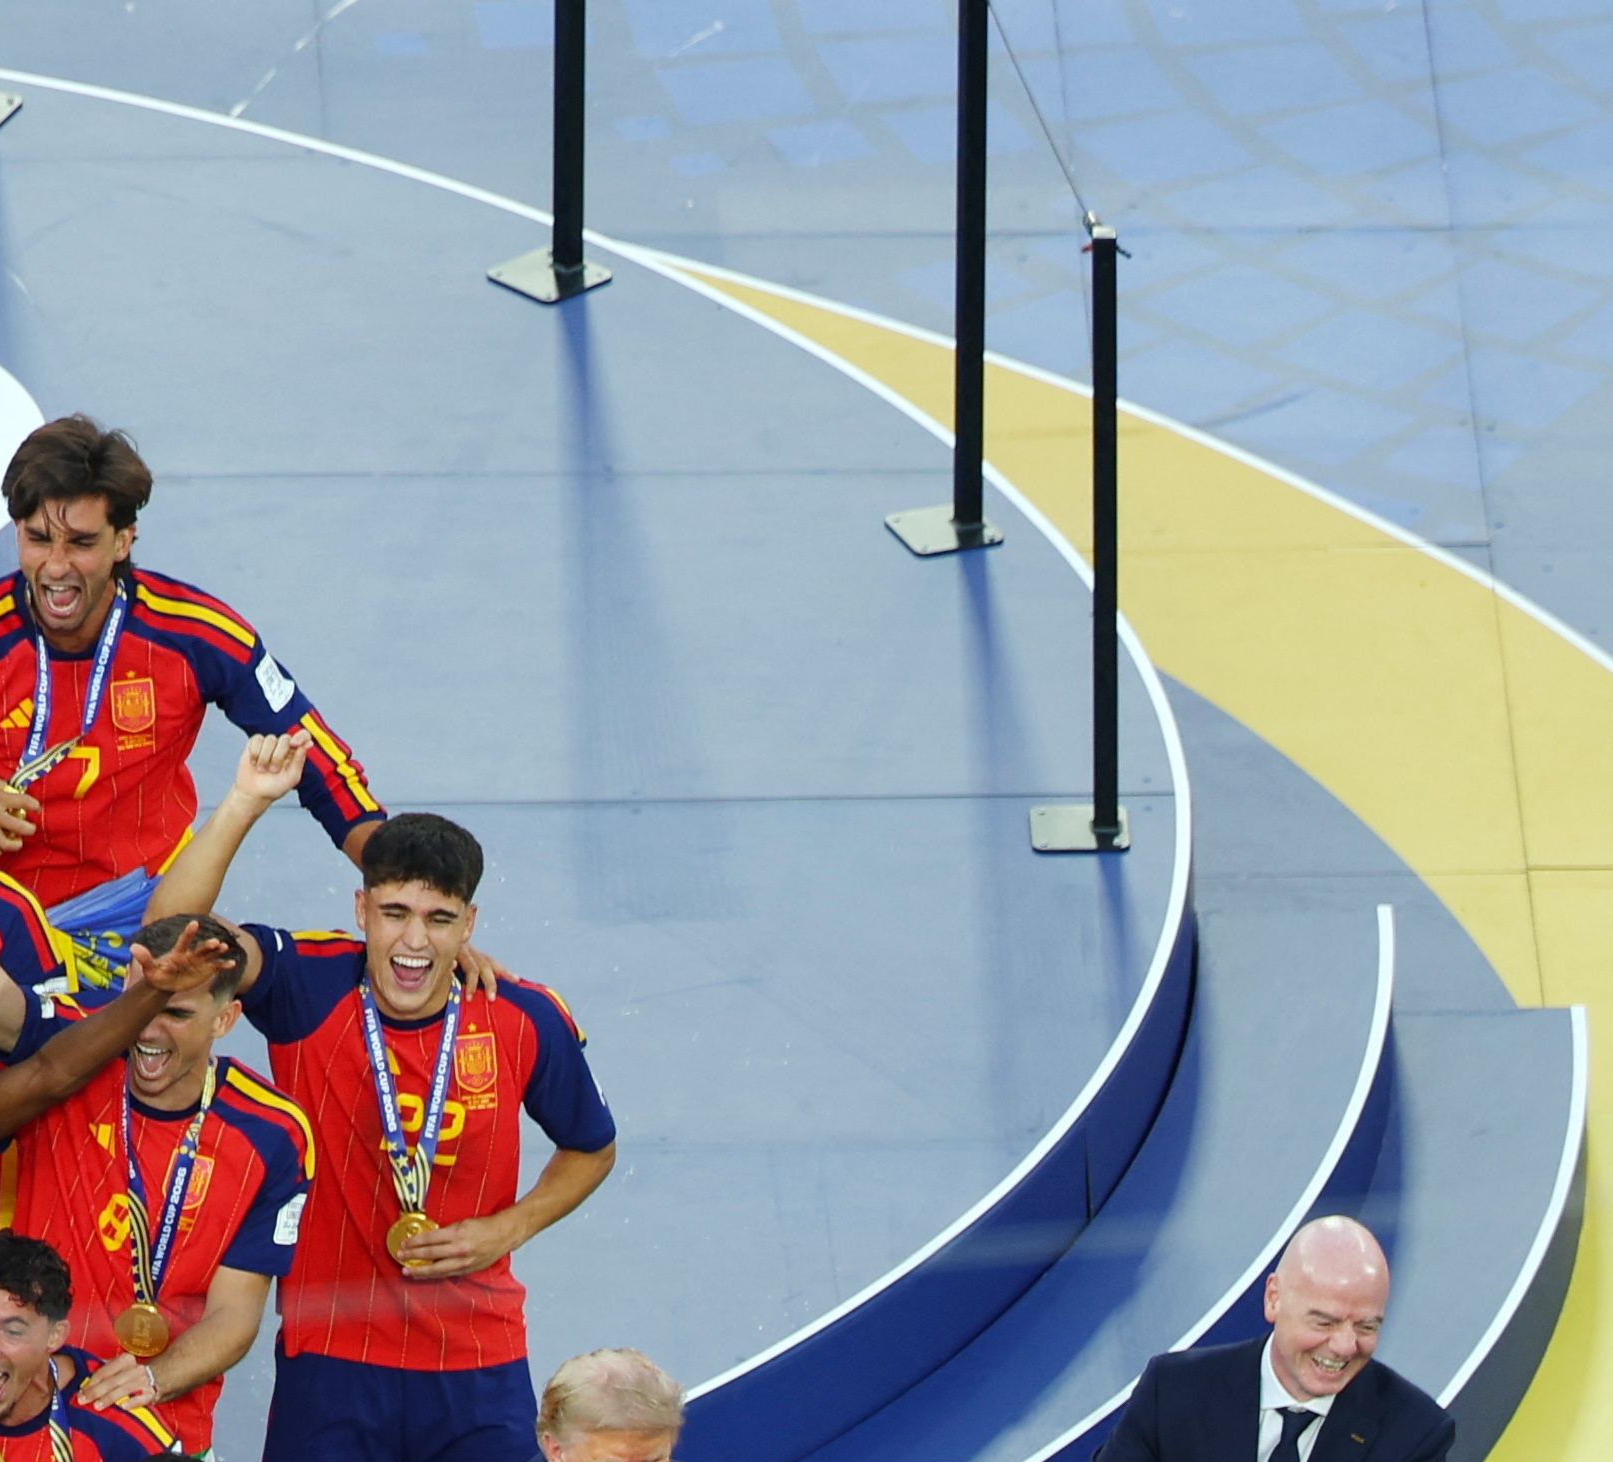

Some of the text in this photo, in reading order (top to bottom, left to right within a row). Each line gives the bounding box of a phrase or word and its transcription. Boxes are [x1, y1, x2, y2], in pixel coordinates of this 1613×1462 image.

[38, 670, 48, 695] CUP
[85, 608, 122, 725] FIFA WORLD CUP 2026
[34, 693, 47, 732] WORLD
[27, 733, 41, 756] FIFA
[66, 746, 100, 800] 7
[364, 1008, 397, 1133] FIFA WORLD CUP 2026
[424, 1013, 456, 1139] FIFA WORLD CUP 2026
[170, 1167, 187, 1205] 2026
[164, 1204, 177, 1225] CUP
[155, 1225, 172, 1259] WORLD
